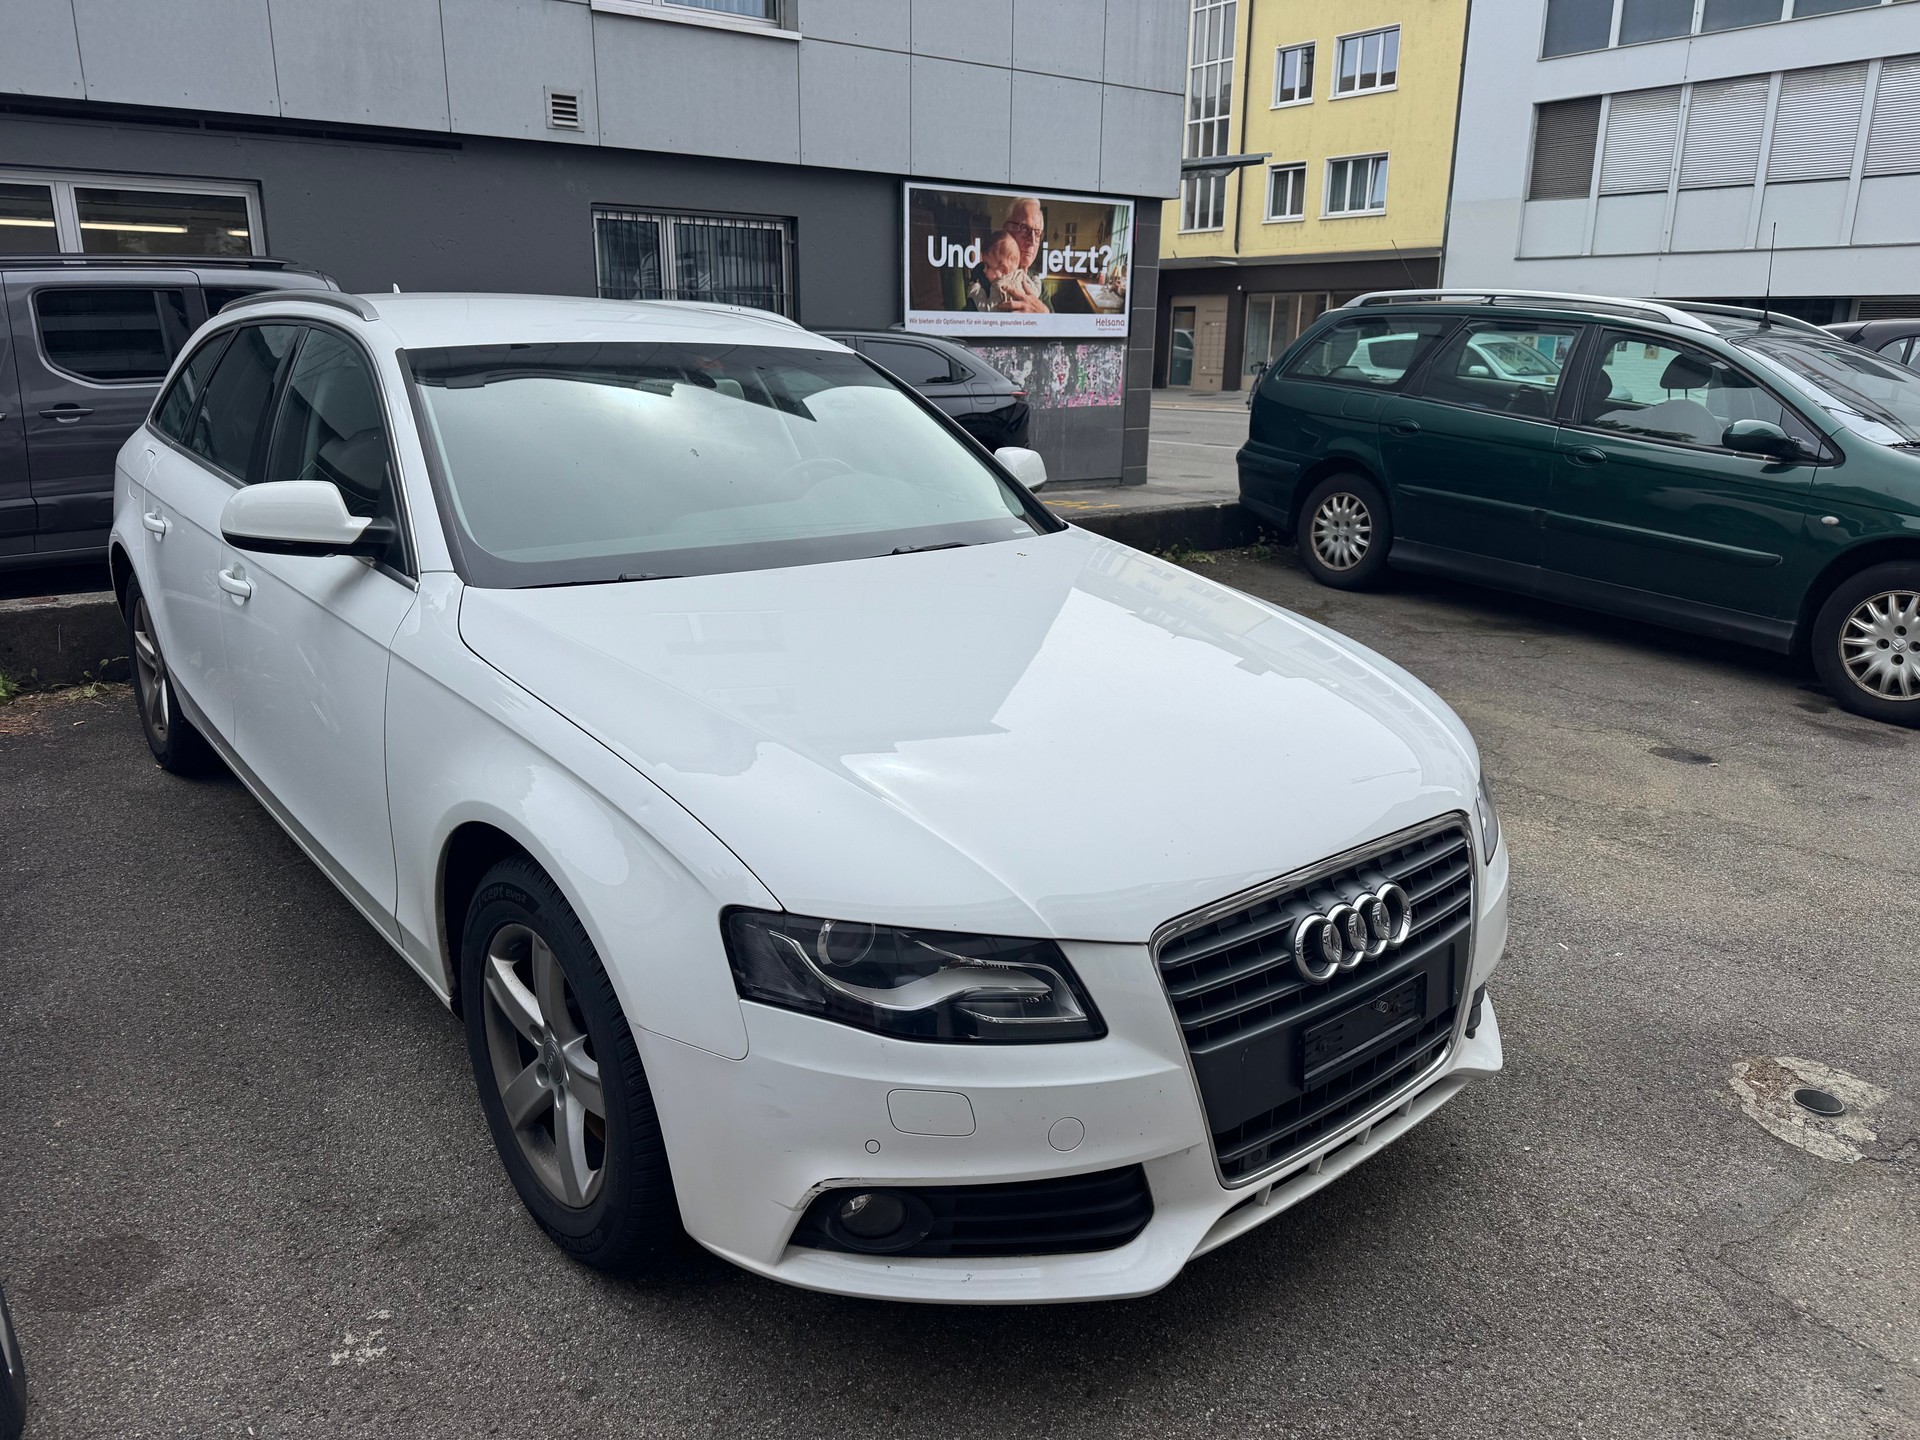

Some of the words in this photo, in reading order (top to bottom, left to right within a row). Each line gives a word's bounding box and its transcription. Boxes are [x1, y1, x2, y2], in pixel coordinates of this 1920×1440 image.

[928, 235, 981, 269] Und
[1039, 242, 1112, 278] jetzt?
[1000, 319, 1022, 327] gesundes
[1096, 317, 1125, 327] Helsana
